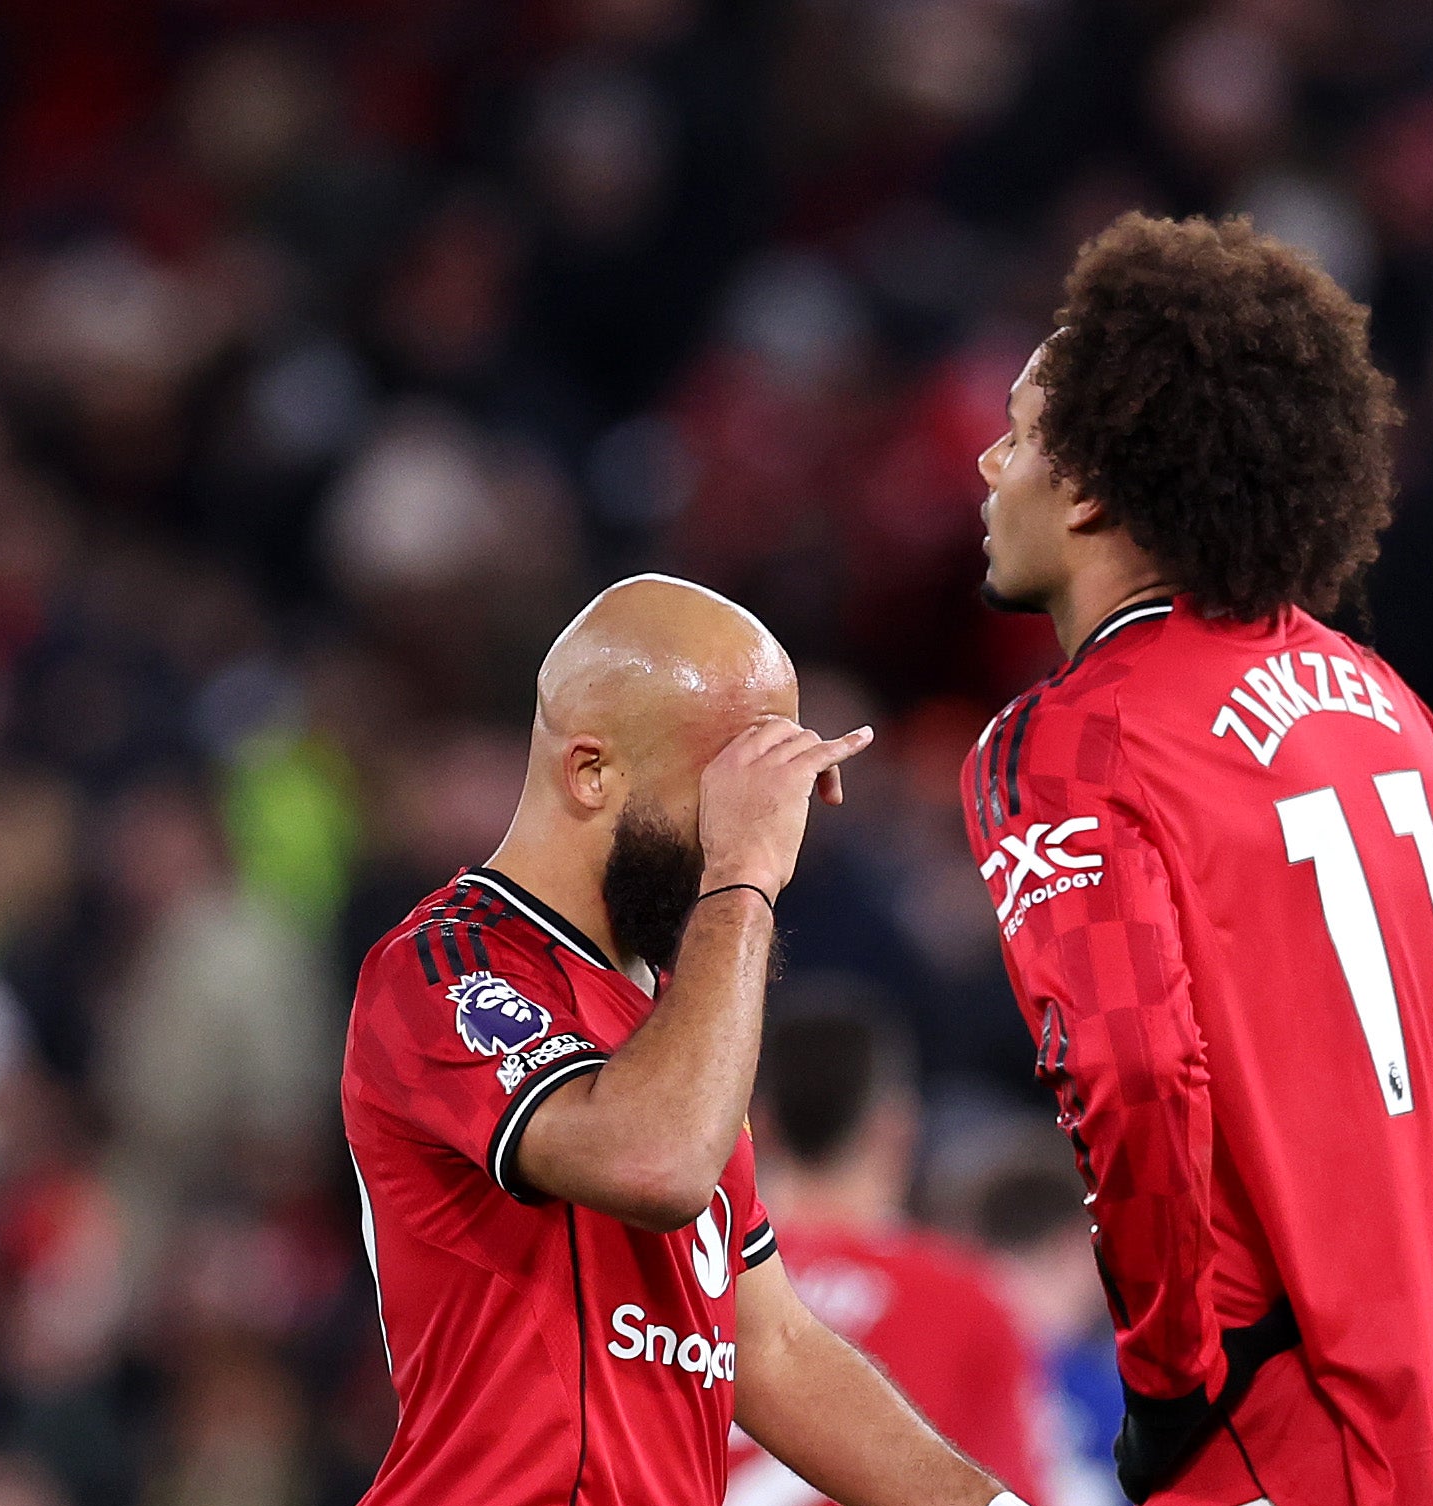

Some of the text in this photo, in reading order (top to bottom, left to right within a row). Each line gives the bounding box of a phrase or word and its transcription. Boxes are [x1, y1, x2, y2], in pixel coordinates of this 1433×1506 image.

[1211, 651, 1402, 768] ZIRKZEE
[979, 816, 1104, 924] DXC
[1003, 871, 1104, 943] TECNOLOGY
